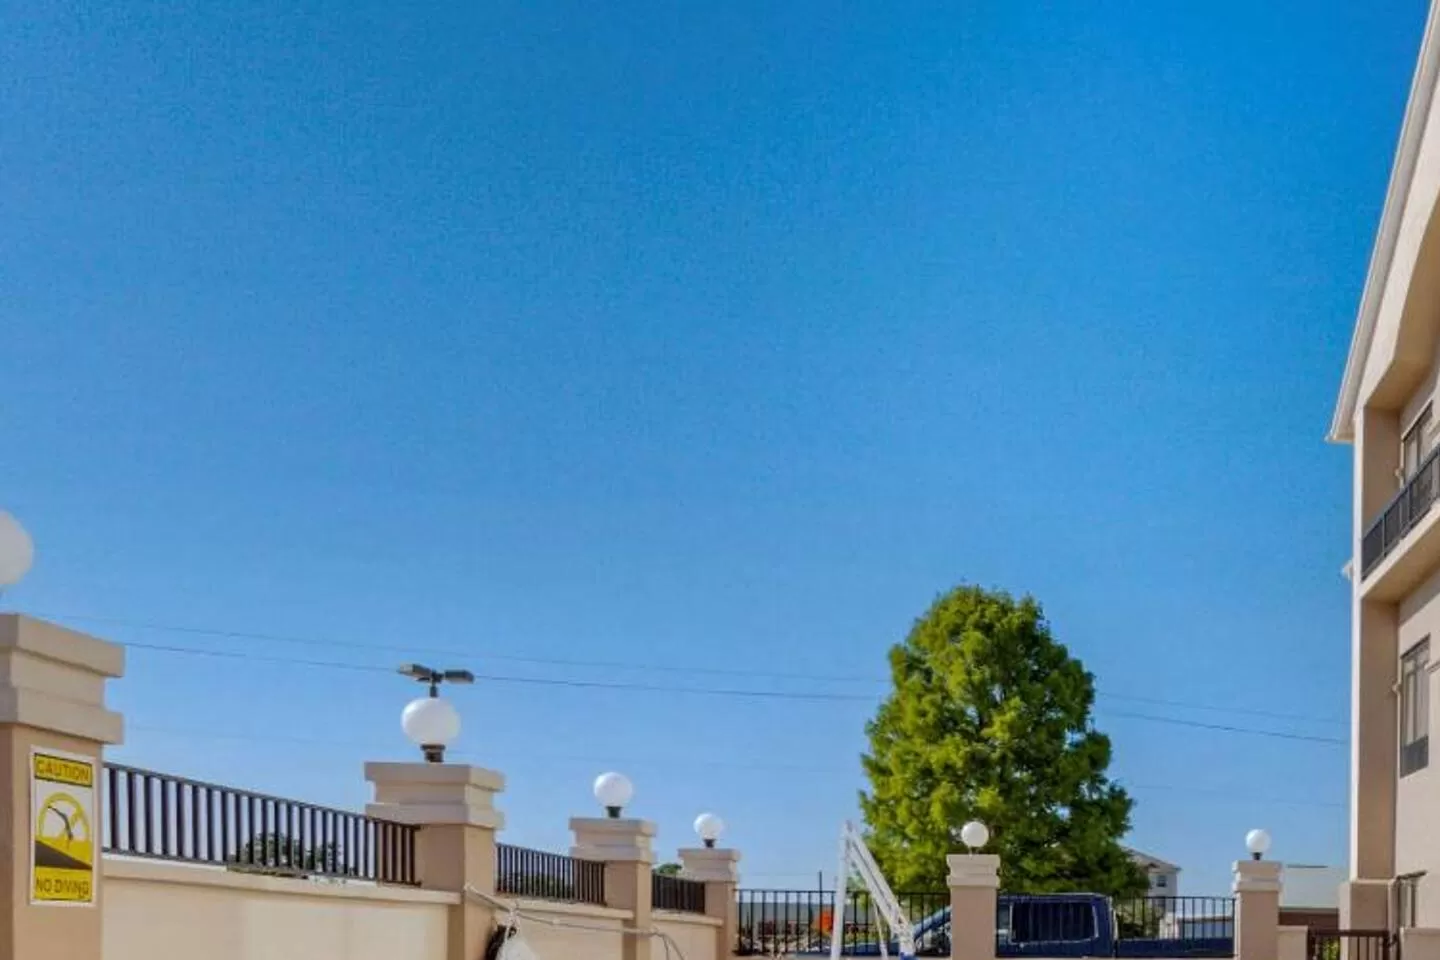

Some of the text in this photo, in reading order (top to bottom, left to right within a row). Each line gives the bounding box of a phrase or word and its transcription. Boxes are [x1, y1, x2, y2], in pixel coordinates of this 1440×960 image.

[36, 759, 90, 782] CAUTION
[36, 877, 90, 896] NO DIVING
